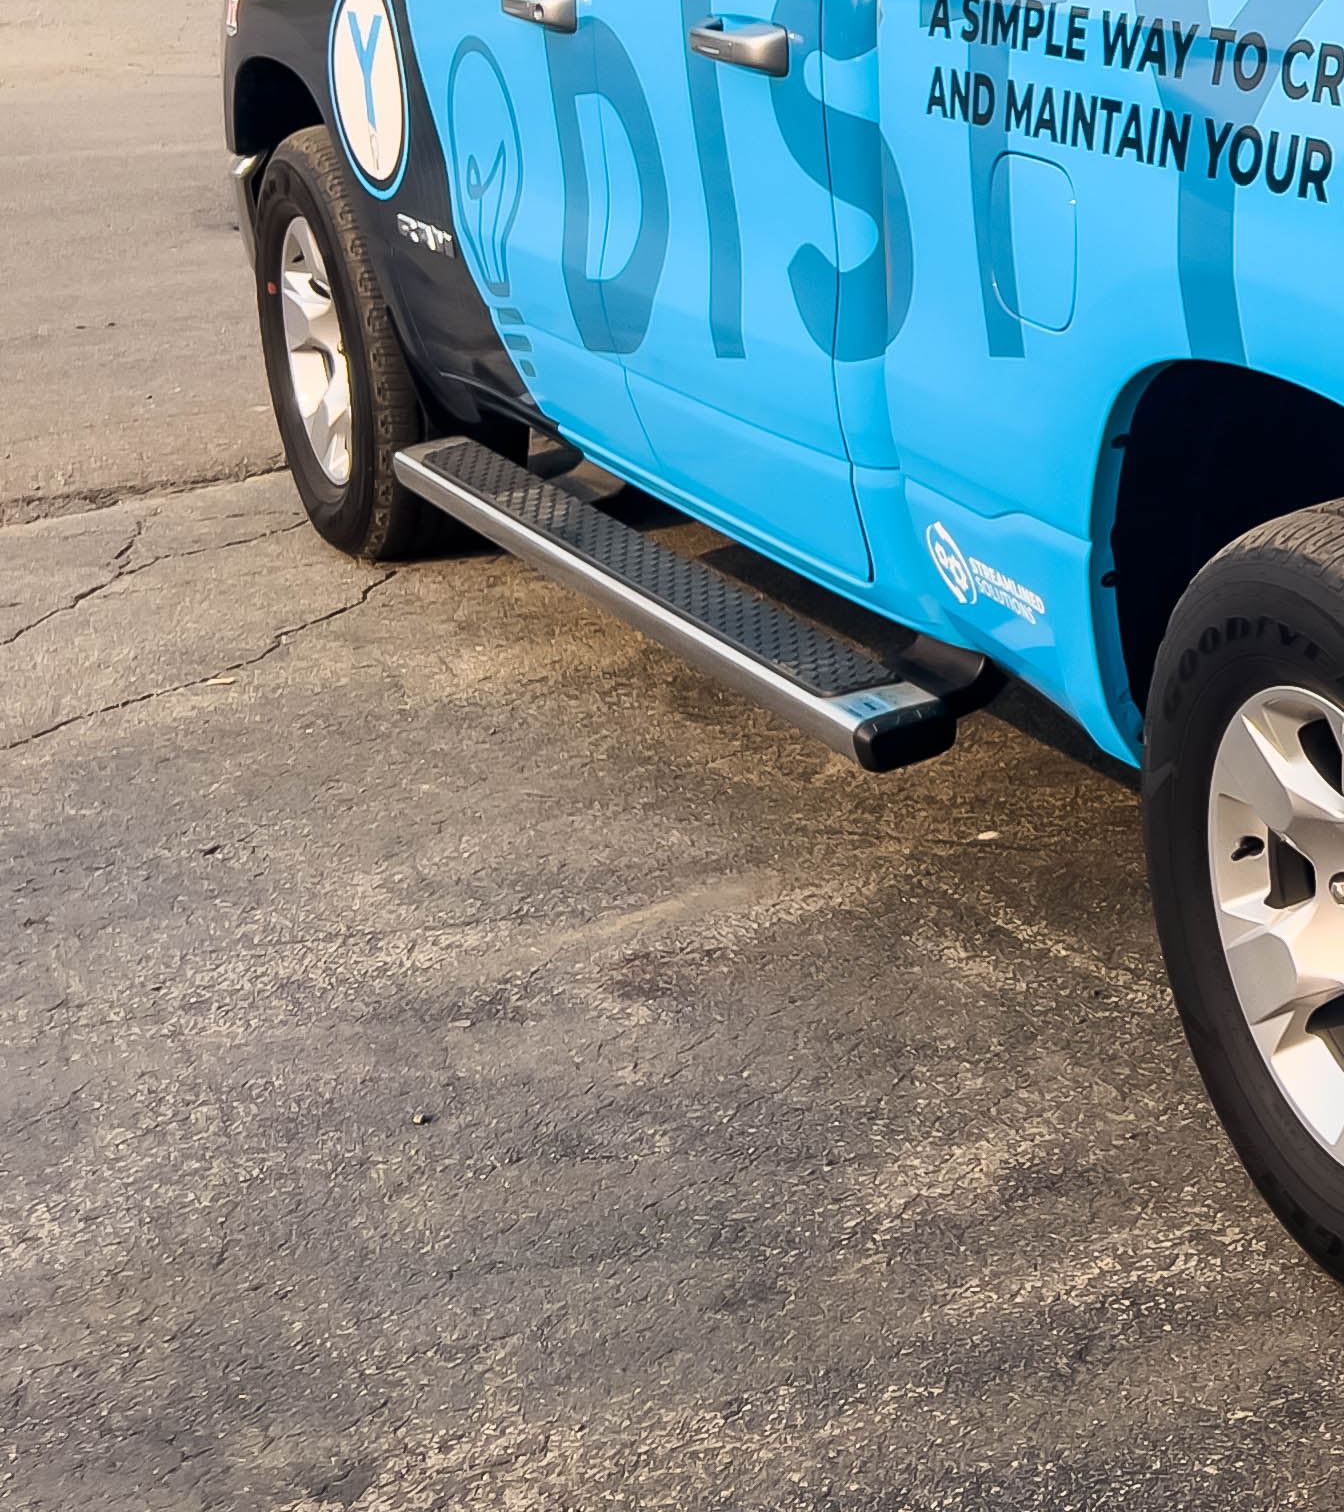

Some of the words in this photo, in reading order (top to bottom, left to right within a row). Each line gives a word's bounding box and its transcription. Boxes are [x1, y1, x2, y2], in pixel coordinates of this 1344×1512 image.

[1102, 10, 1199, 79] WAY
[1209, 27, 1268, 92] TO
[926, 65, 995, 127] AND
[1005, 79, 1192, 173] MAINTAIN
[1204, 117, 1334, 204] YOUR
